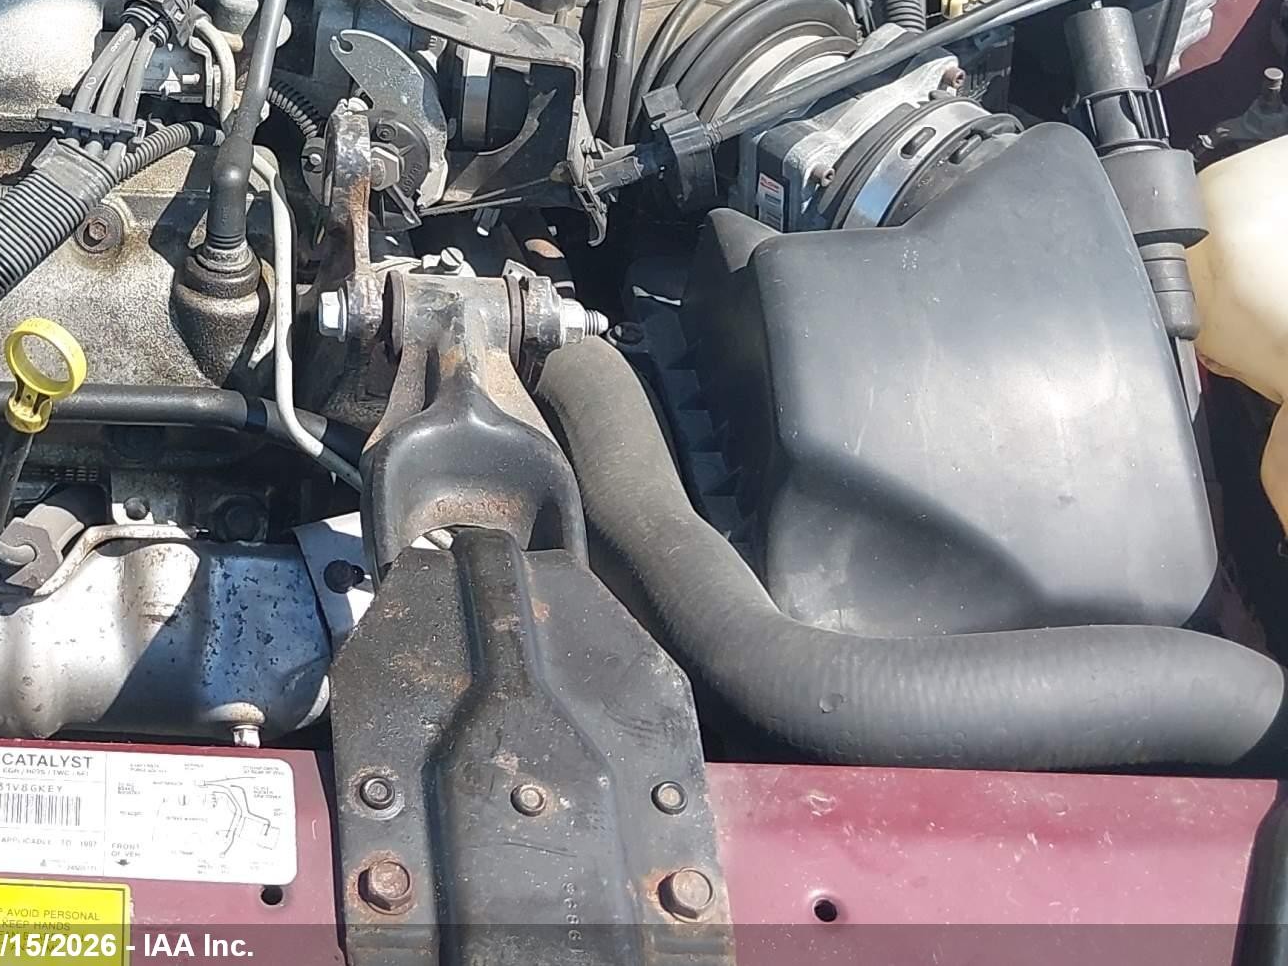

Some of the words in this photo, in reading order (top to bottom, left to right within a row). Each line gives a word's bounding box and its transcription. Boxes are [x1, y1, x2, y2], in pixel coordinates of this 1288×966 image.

[2, 753, 93, 769] CATALYST
[7, 908, 40, 918] AVOID
[43, 909, 101, 921] PERSONAL
[2, 918, 30, 930] KEEP
[33, 922, 71, 932] HANDS
